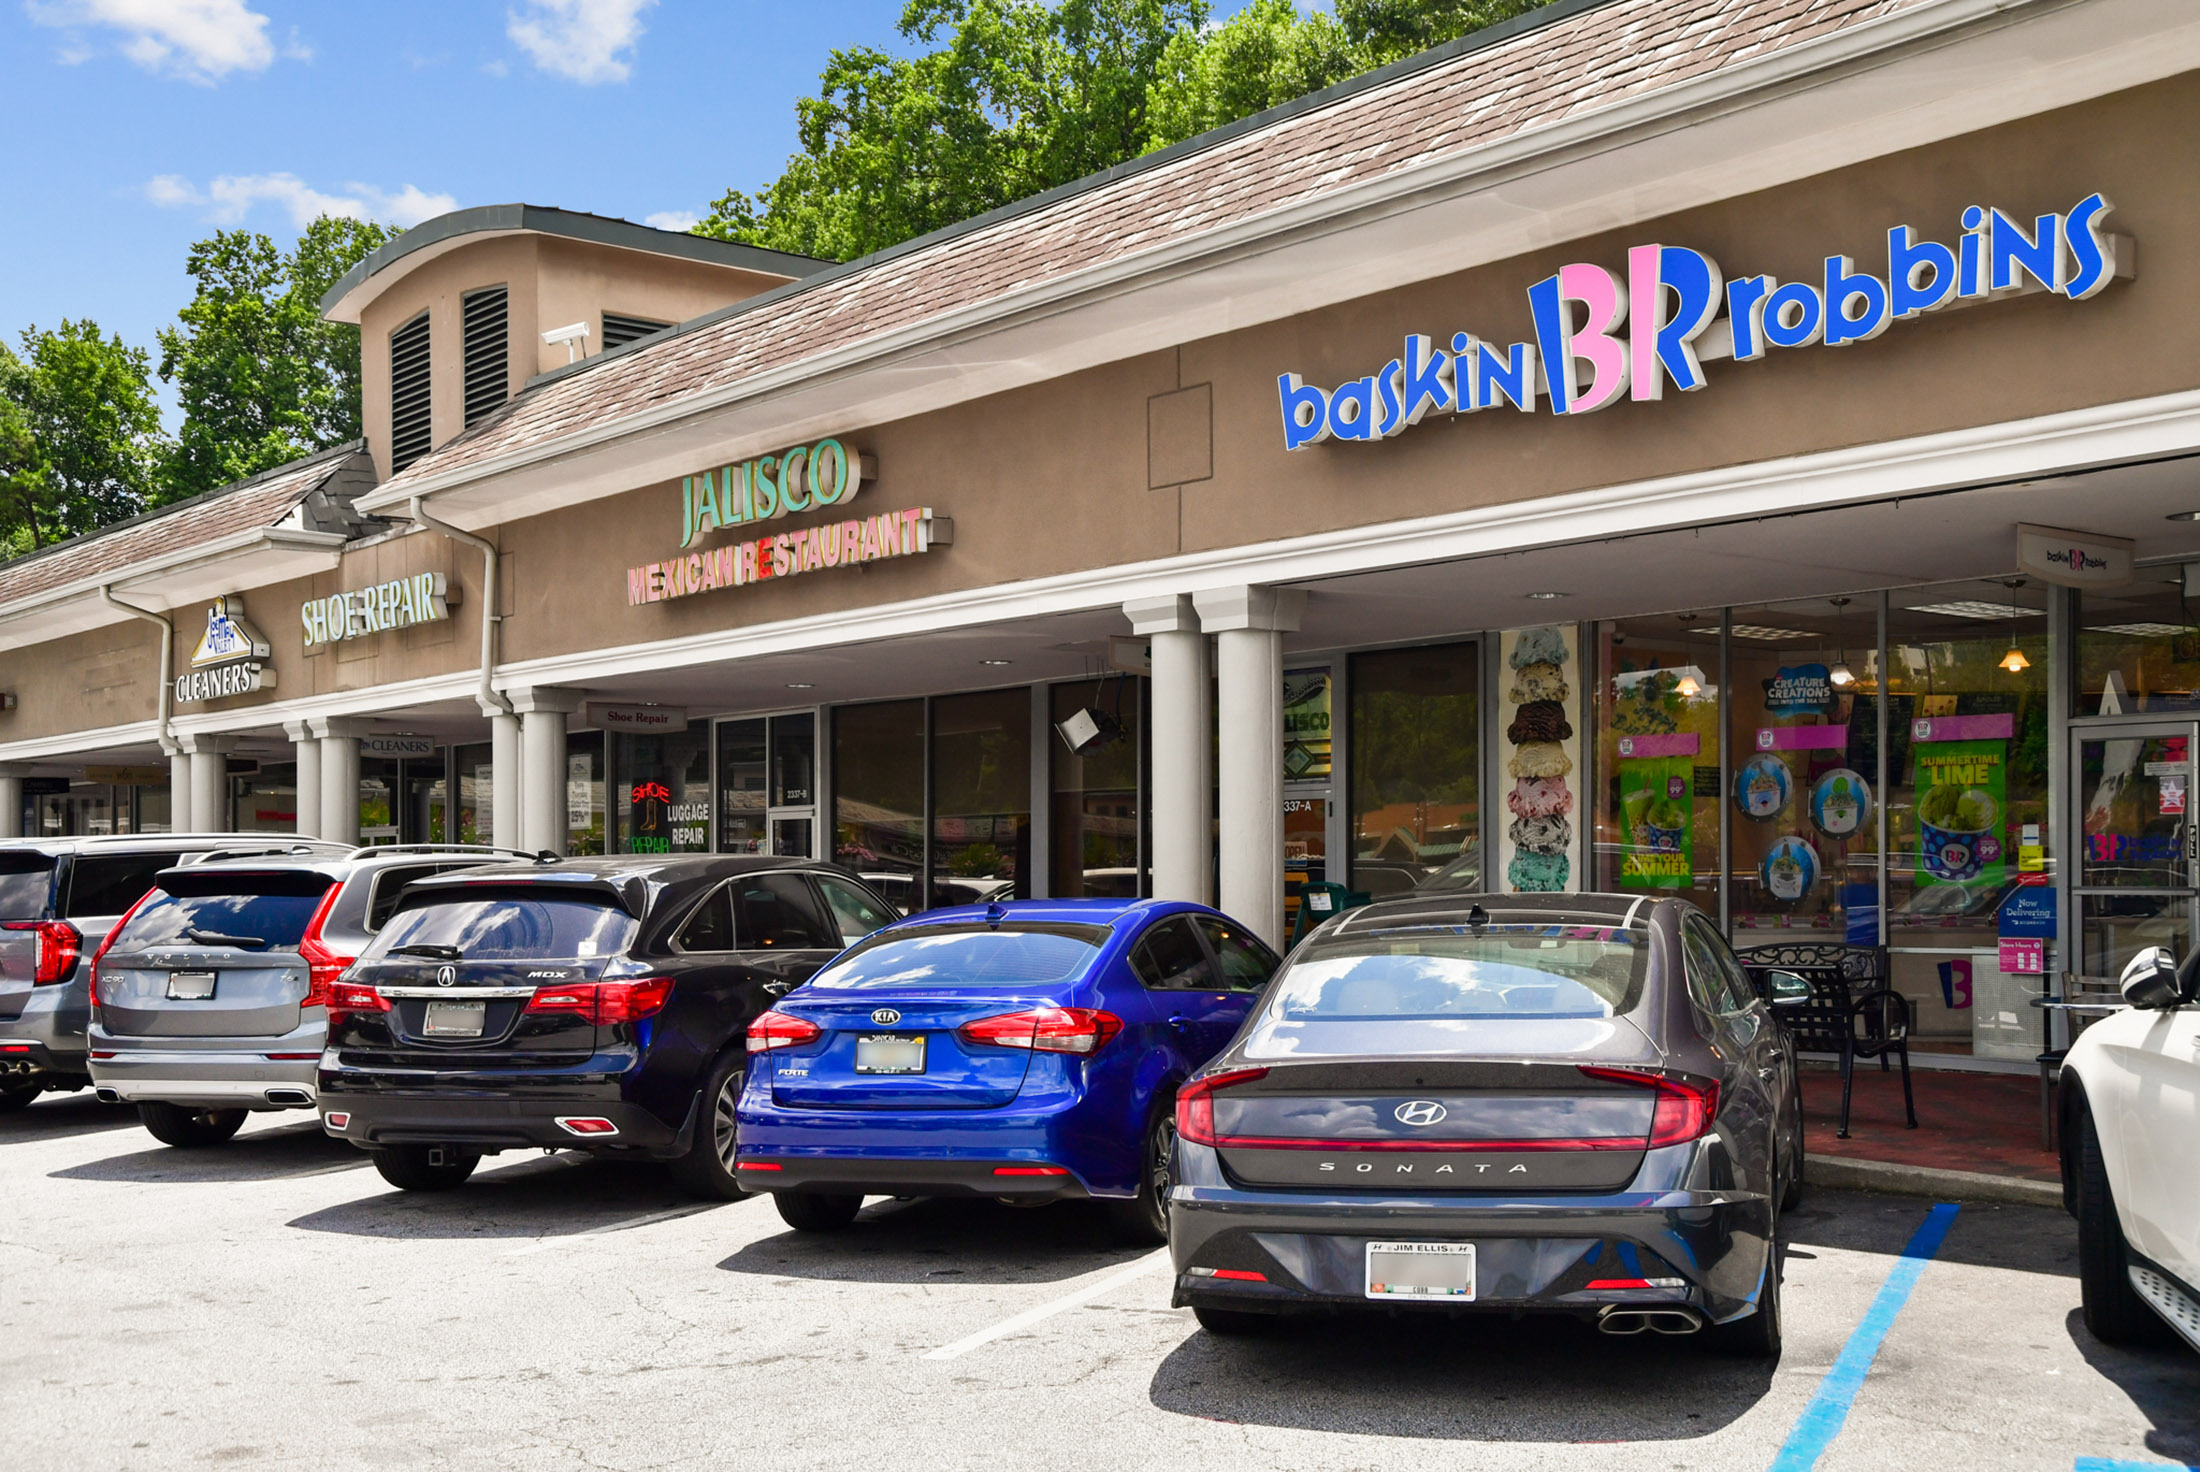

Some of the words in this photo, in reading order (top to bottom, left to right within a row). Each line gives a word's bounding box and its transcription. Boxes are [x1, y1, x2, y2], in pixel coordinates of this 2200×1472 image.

[1277, 332, 1535, 452] baskin
[1526, 243, 1724, 416] BR
[1726, 192, 2113, 362] robbins
[680, 438, 850, 549] JALISCO
[627, 545, 738, 606] MEXICAN
[740, 506, 926, 583] RESTAURANT
[2046, 550, 2069, 563] baskin
[2069, 549, 2085, 571] BR
[302, 591, 358, 647] SHOE
[364, 571, 438, 633] REPAIR
[176, 661, 252, 703] CLEANERS
[1773, 677, 1825, 689] CREATURE
[1767, 687, 1831, 699] CREATIONS
[607, 710, 633, 722] Shoe
[635, 712, 669, 725] Repair
[371, 739, 430, 753] CLEANERS
[1920, 754, 2001, 767] SUMMERTIME
[1930, 764, 1990, 786] LIME
[631, 782, 670, 803] SHOE
[787, 790, 807, 799] 2337-B
[667, 804, 709, 822] LUGGAGE
[1284, 801, 1311, 811] 337-A
[672, 827, 704, 845] REPAIR
[631, 836, 670, 854] REPAIR
[2087, 833, 2128, 862] BR
[1657, 853, 1686, 863] YOUR
[1946, 849, 1966, 864] BR
[1622, 862, 1690, 876] SUMMER
[2018, 898, 2038, 908] Now
[2006, 907, 2051, 919] Delivering
[101, 975, 125, 984] XC90
[527, 971, 569, 979] MDX
[874, 1011, 896, 1023] KIA
[778, 1068, 809, 1077] FORTE
[1318, 1162, 1528, 1174] SONATA
[1393, 1244, 1414, 1252] JIM
[1417, 1244, 1449, 1253] ELLIS
